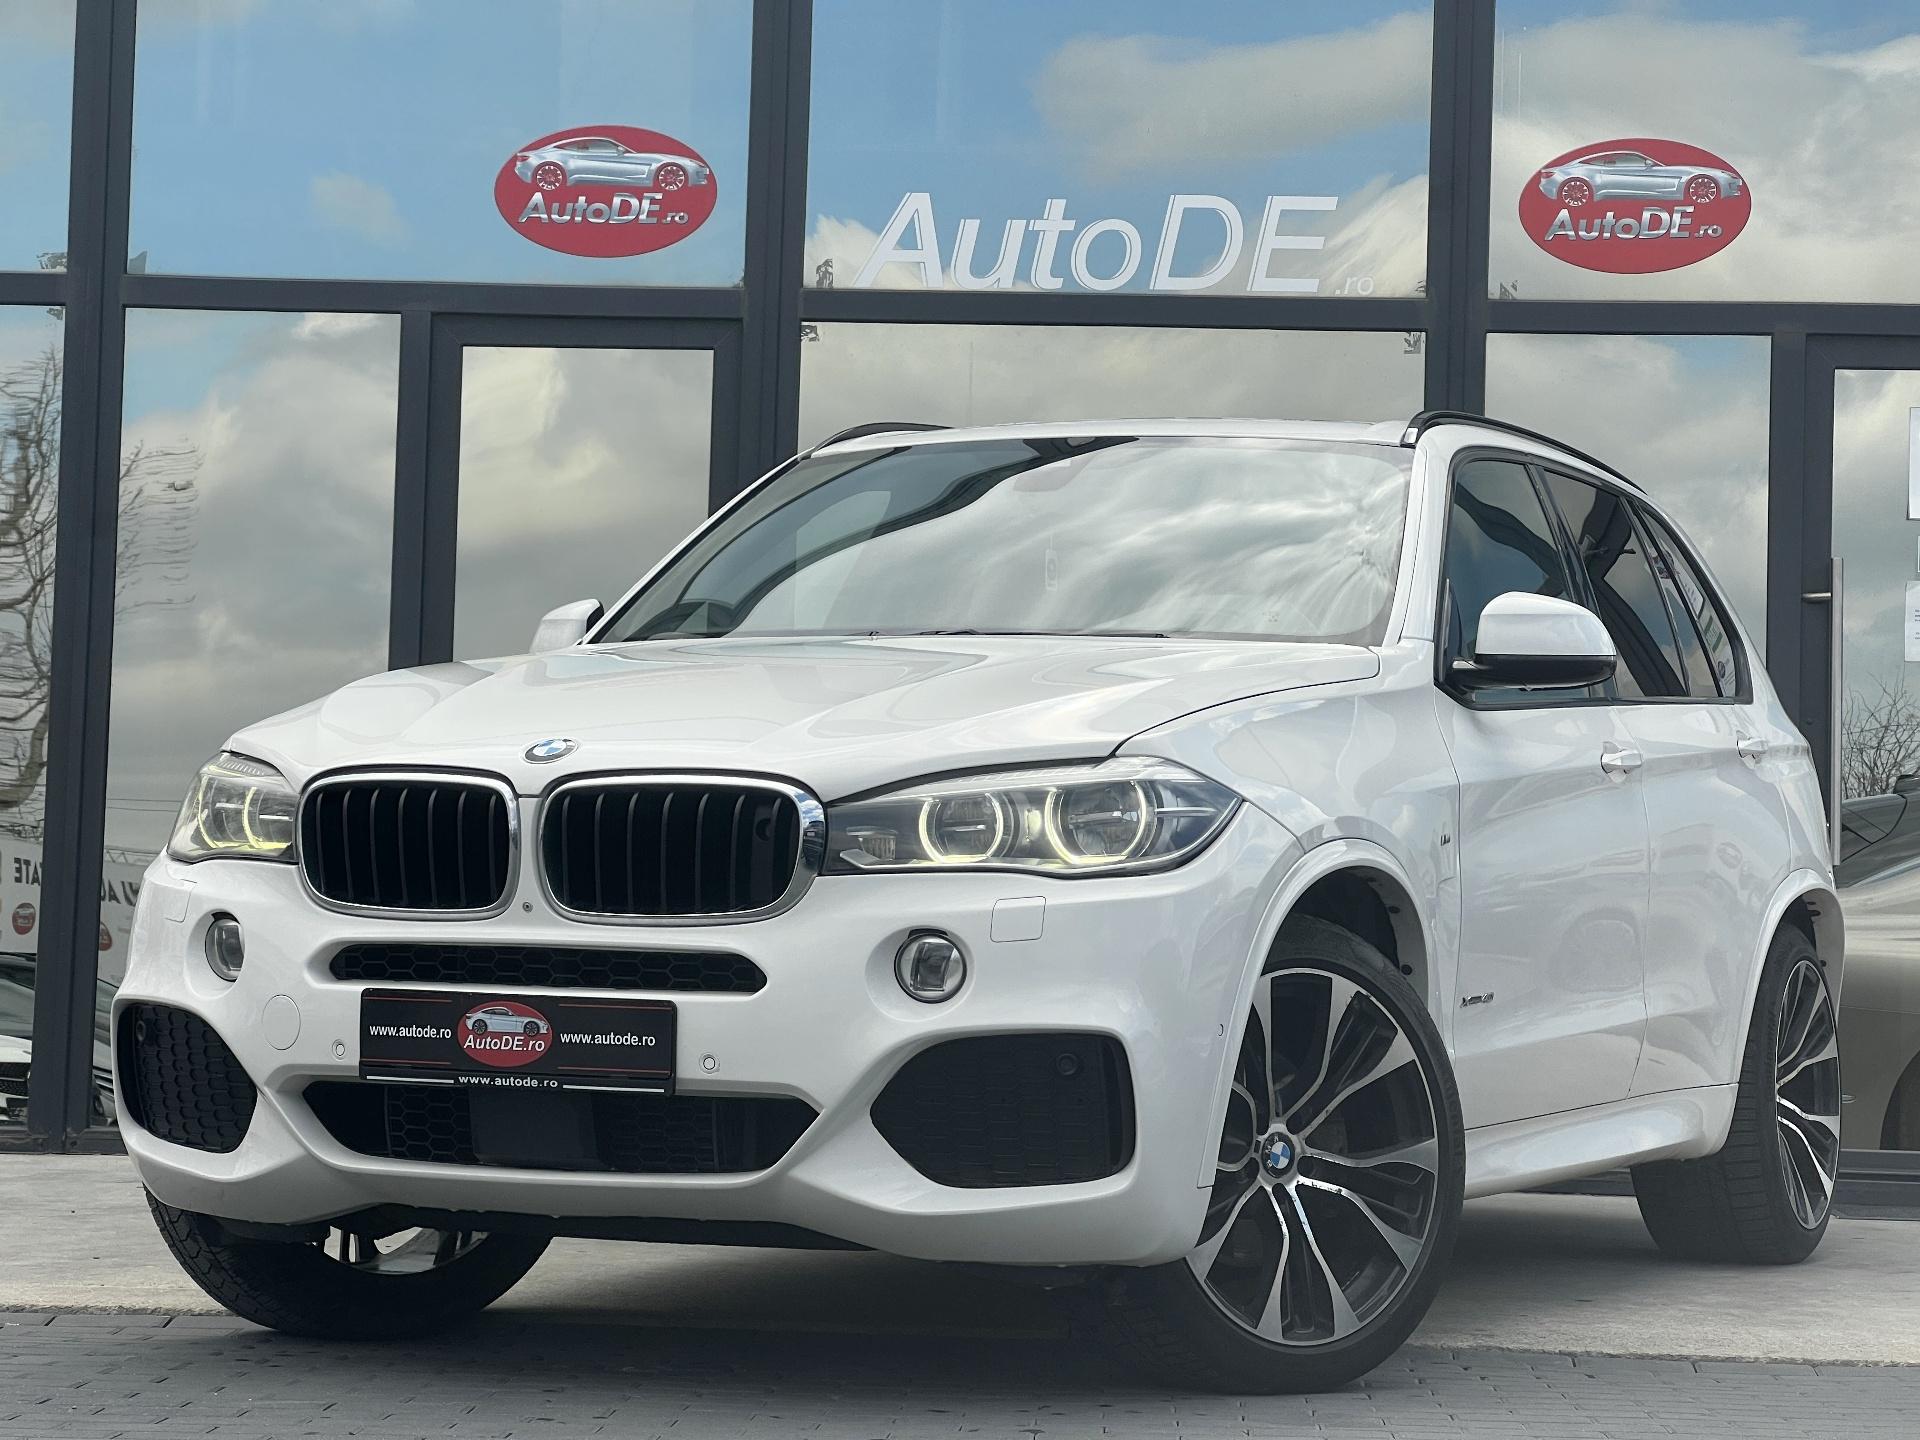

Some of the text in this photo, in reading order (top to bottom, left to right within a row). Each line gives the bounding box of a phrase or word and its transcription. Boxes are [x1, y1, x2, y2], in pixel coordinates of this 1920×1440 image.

[369, 1024, 452, 1039] www.autode.ro
[560, 1031, 656, 1047] www.autode.ro
[463, 1034, 545, 1052] AutoDE.ro
[458, 1076, 558, 1088] www.autode.ro
